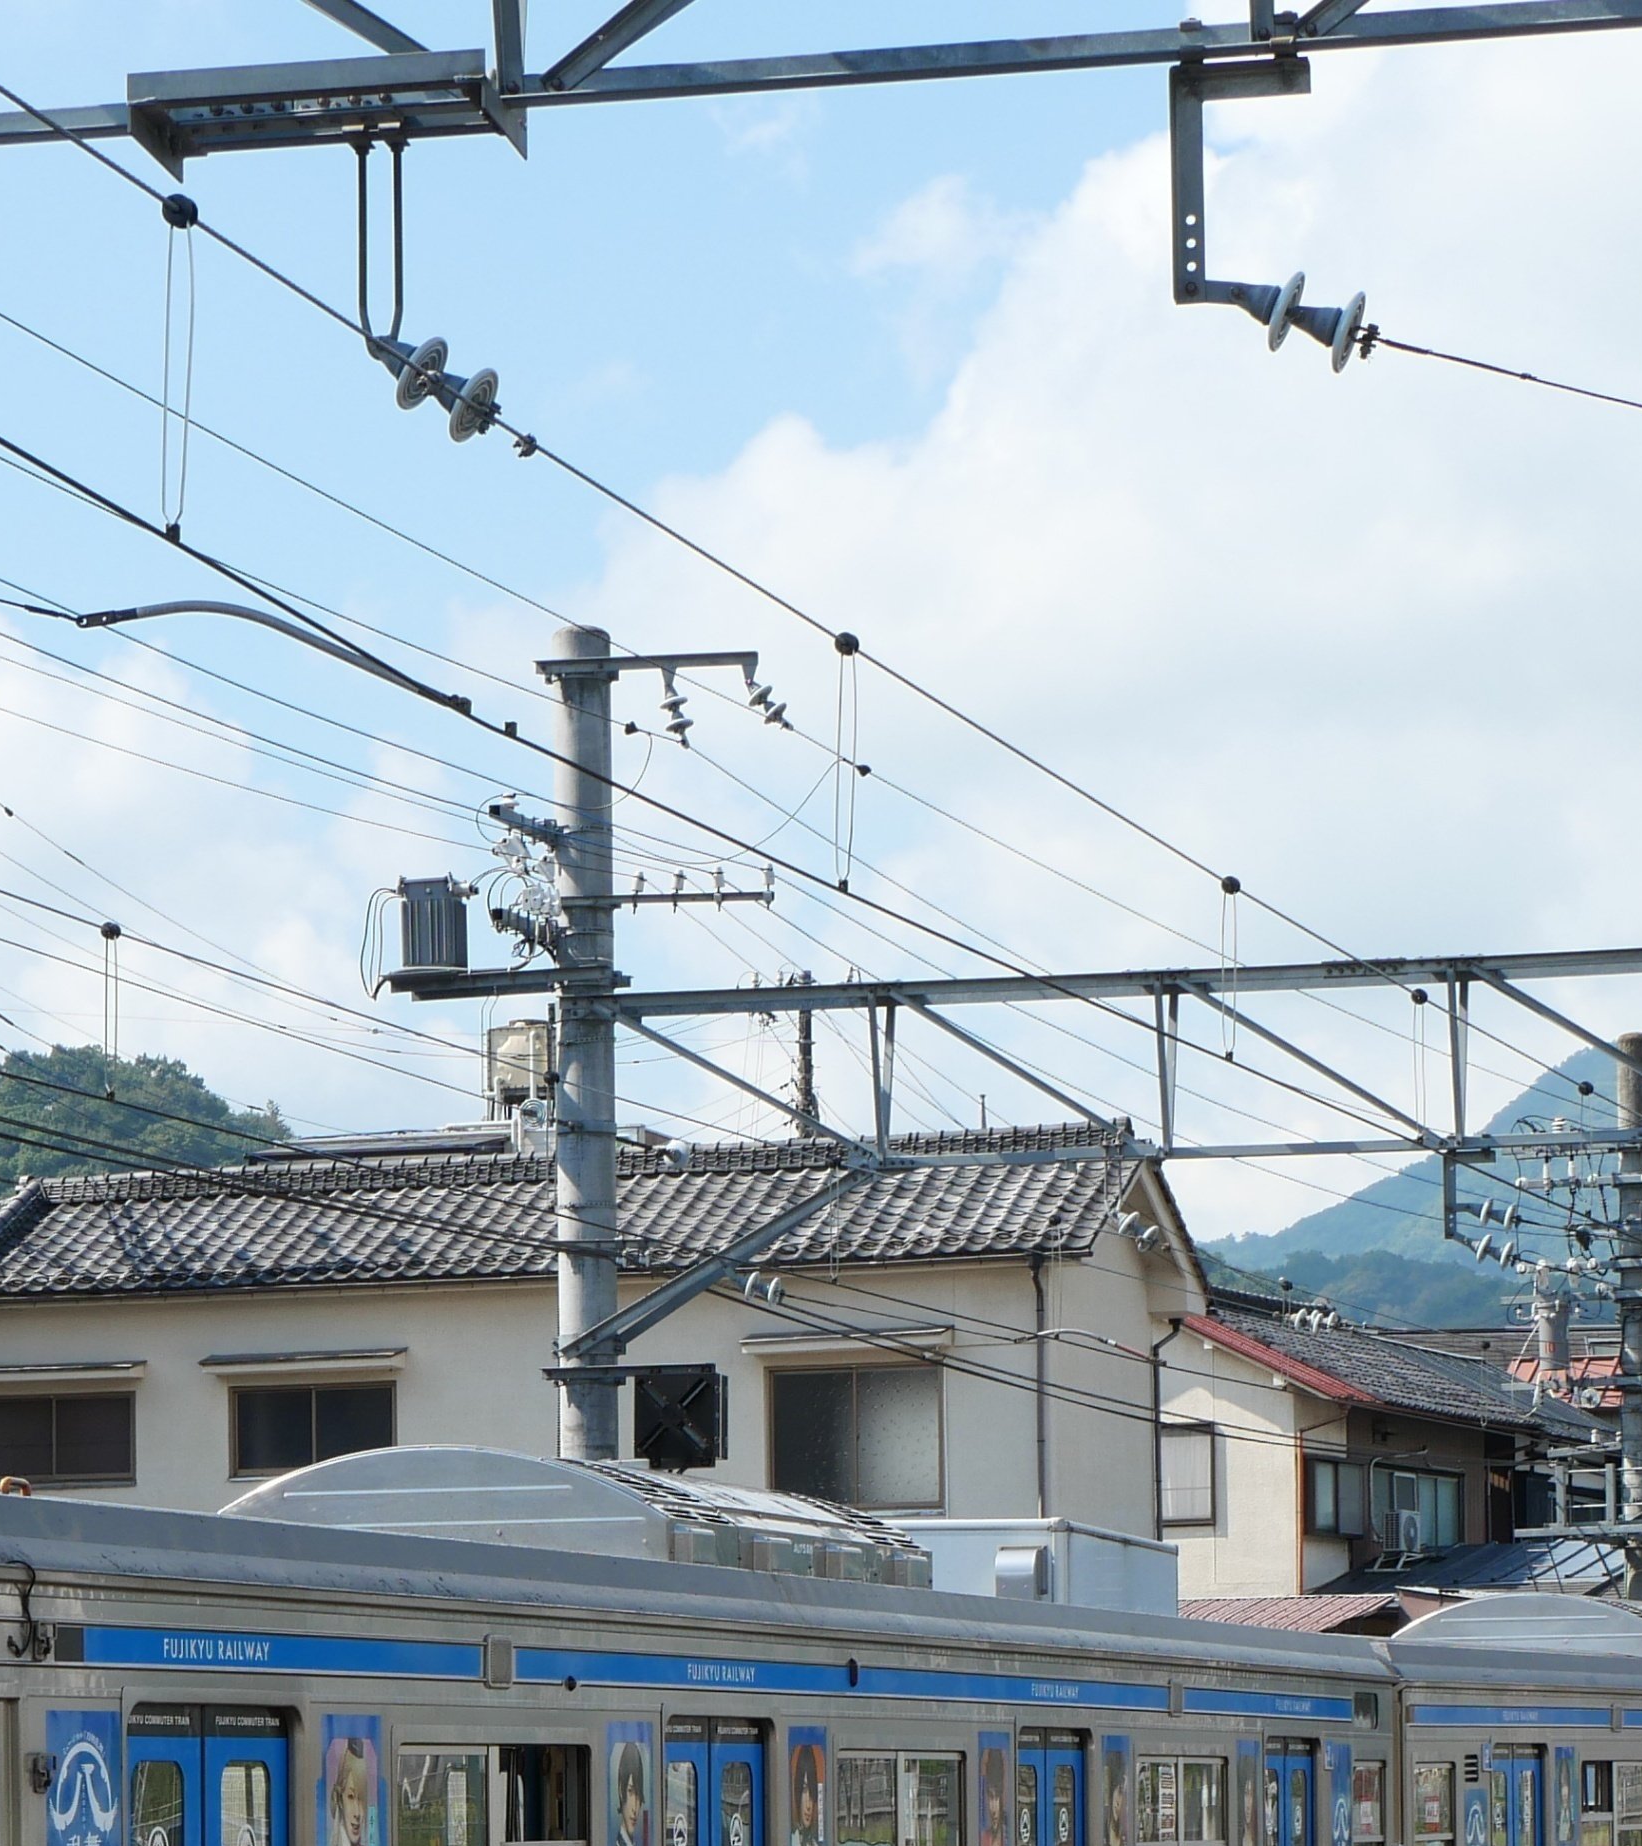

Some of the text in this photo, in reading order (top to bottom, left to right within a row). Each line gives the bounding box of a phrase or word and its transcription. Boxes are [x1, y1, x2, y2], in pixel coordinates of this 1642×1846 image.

[163, 1638, 270, 1662] FUJIKYU RAILWAY
[687, 1663, 755, 1683] FUJIKYU RAILWAY
